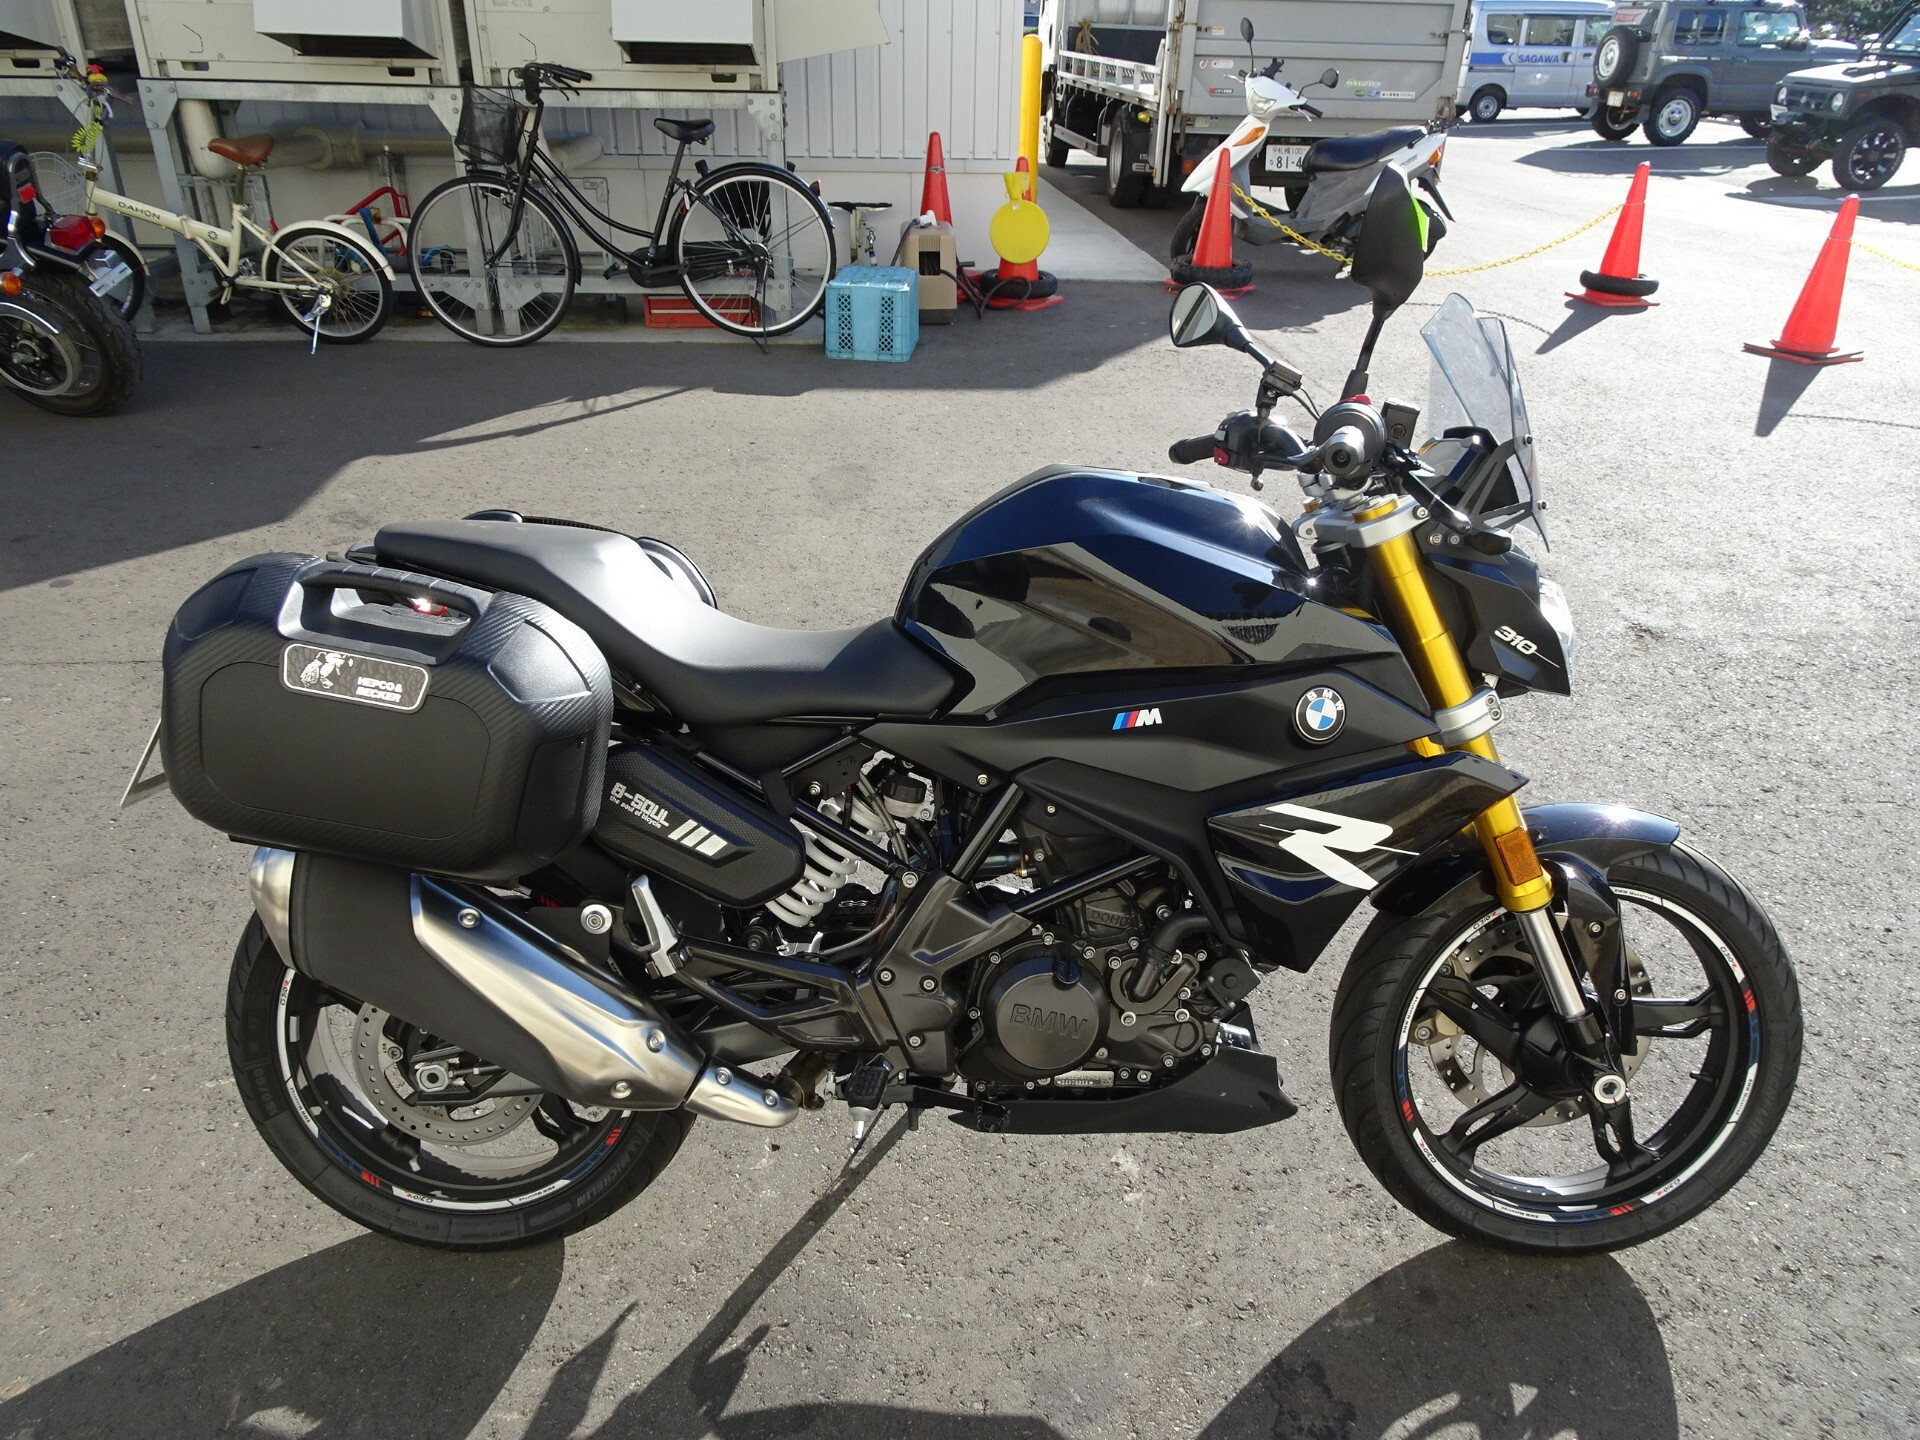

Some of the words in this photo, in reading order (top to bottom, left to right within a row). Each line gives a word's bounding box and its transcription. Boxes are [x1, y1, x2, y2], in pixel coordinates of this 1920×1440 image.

[1517, 54, 1559, 64] SAGAWA
[1131, 162, 1154, 173] EL
[1276, 156, 1303, 170] 81-4
[118, 201, 161, 220] DAHON
[1494, 625, 1538, 655] 310
[355, 686, 402, 702] BECKER
[1306, 688, 1345, 711] BMW
[609, 795, 620, 805] the
[620, 802, 635, 813] soul
[641, 813, 662, 829] bicycle
[610, 782, 669, 827] B-SOUL
[1009, 1003, 1088, 1039] BMW
[575, 1152, 631, 1208] MICHELIN
